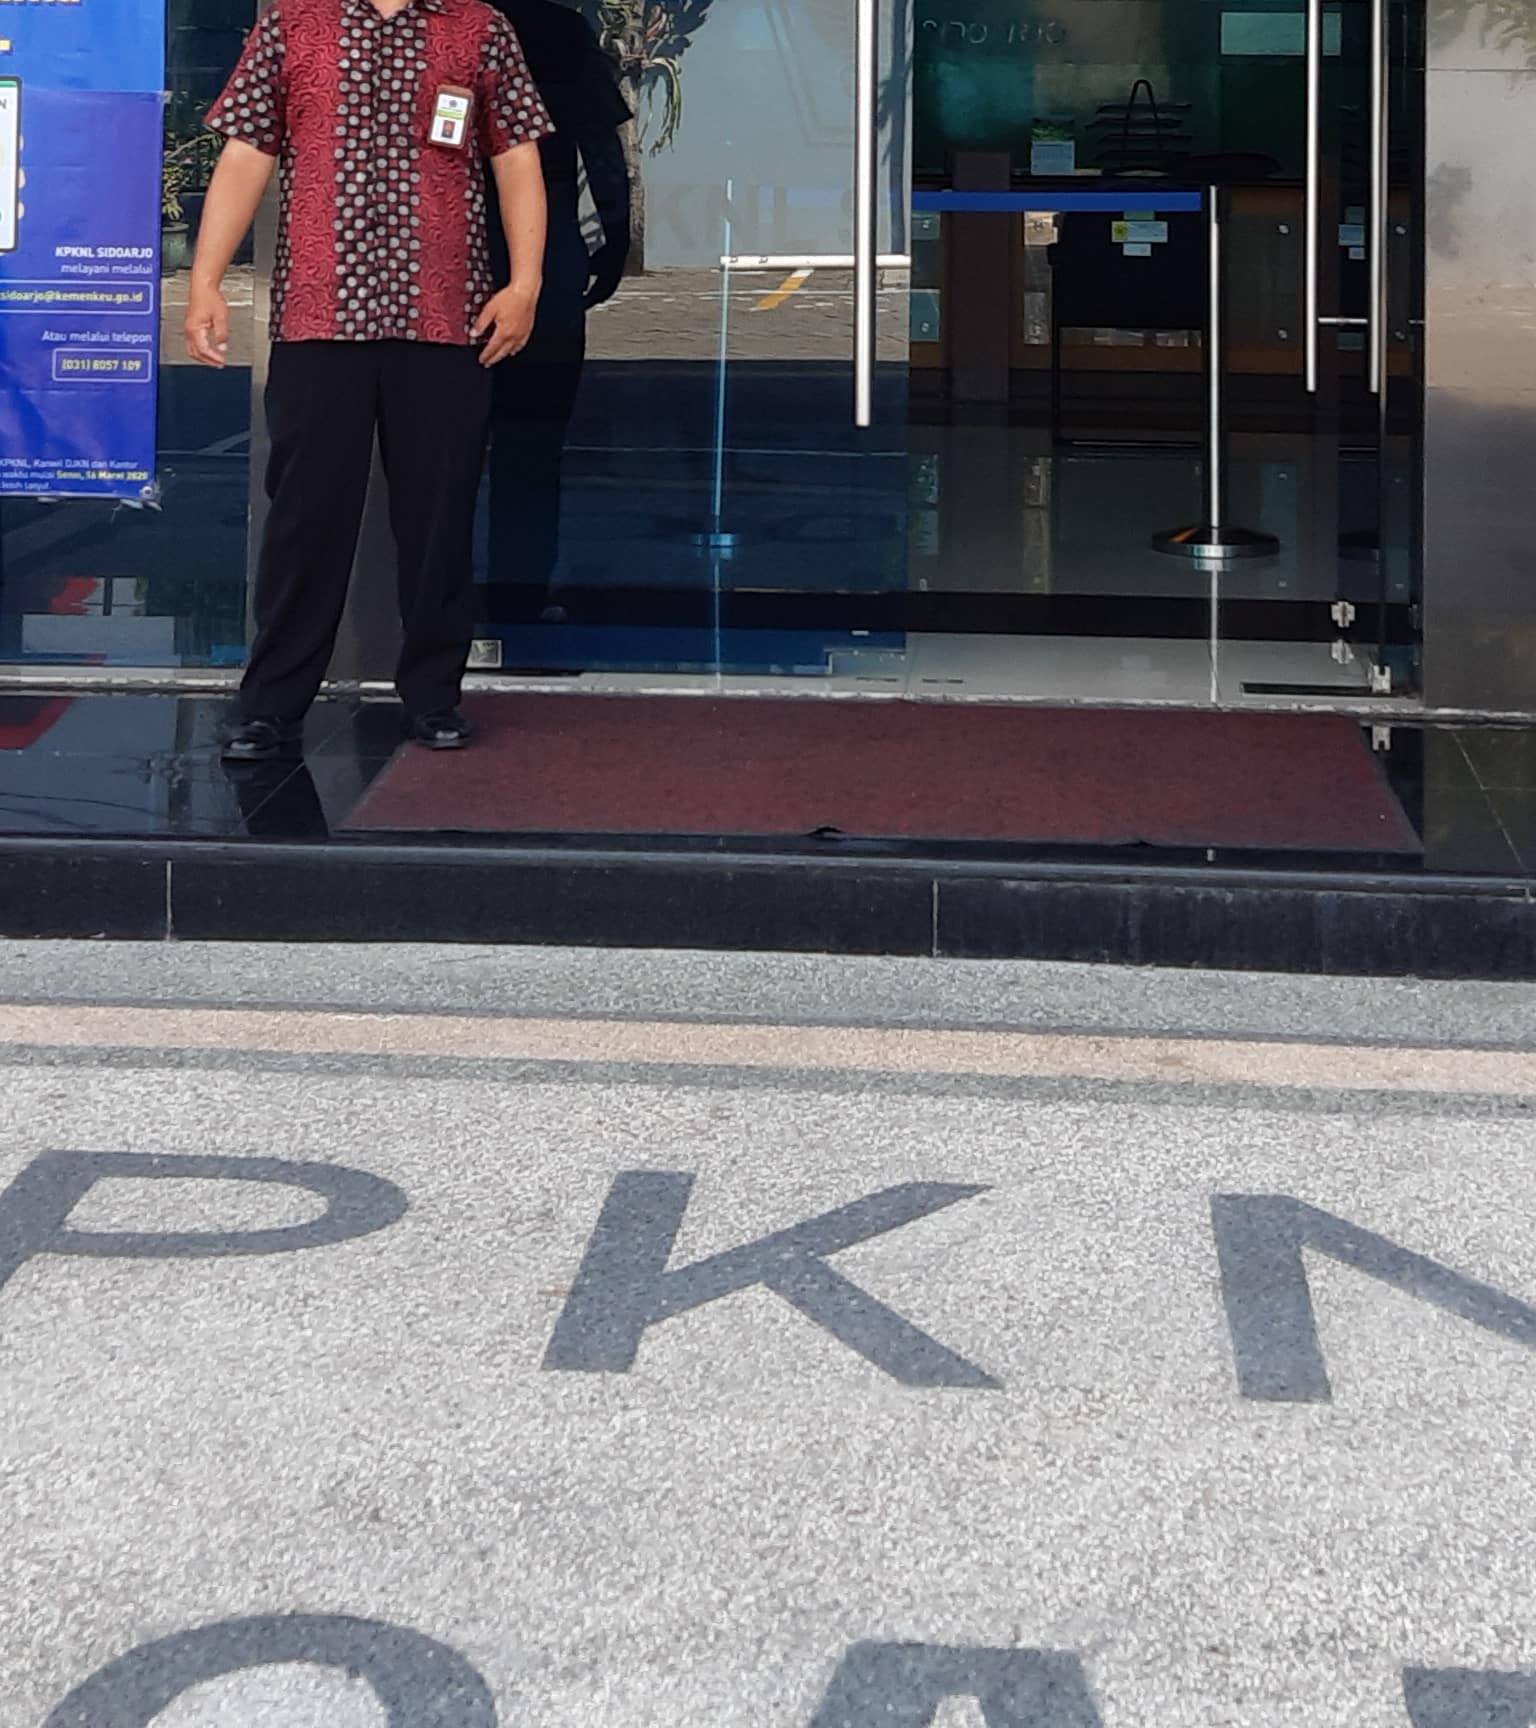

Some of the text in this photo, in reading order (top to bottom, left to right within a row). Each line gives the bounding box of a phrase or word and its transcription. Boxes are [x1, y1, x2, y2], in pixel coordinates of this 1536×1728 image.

[55, 246, 154, 259] KPKNL SIDOARJO
[60, 263, 153, 277] melayani melalui
[42, 330, 153, 345] Atau melalui telepon
